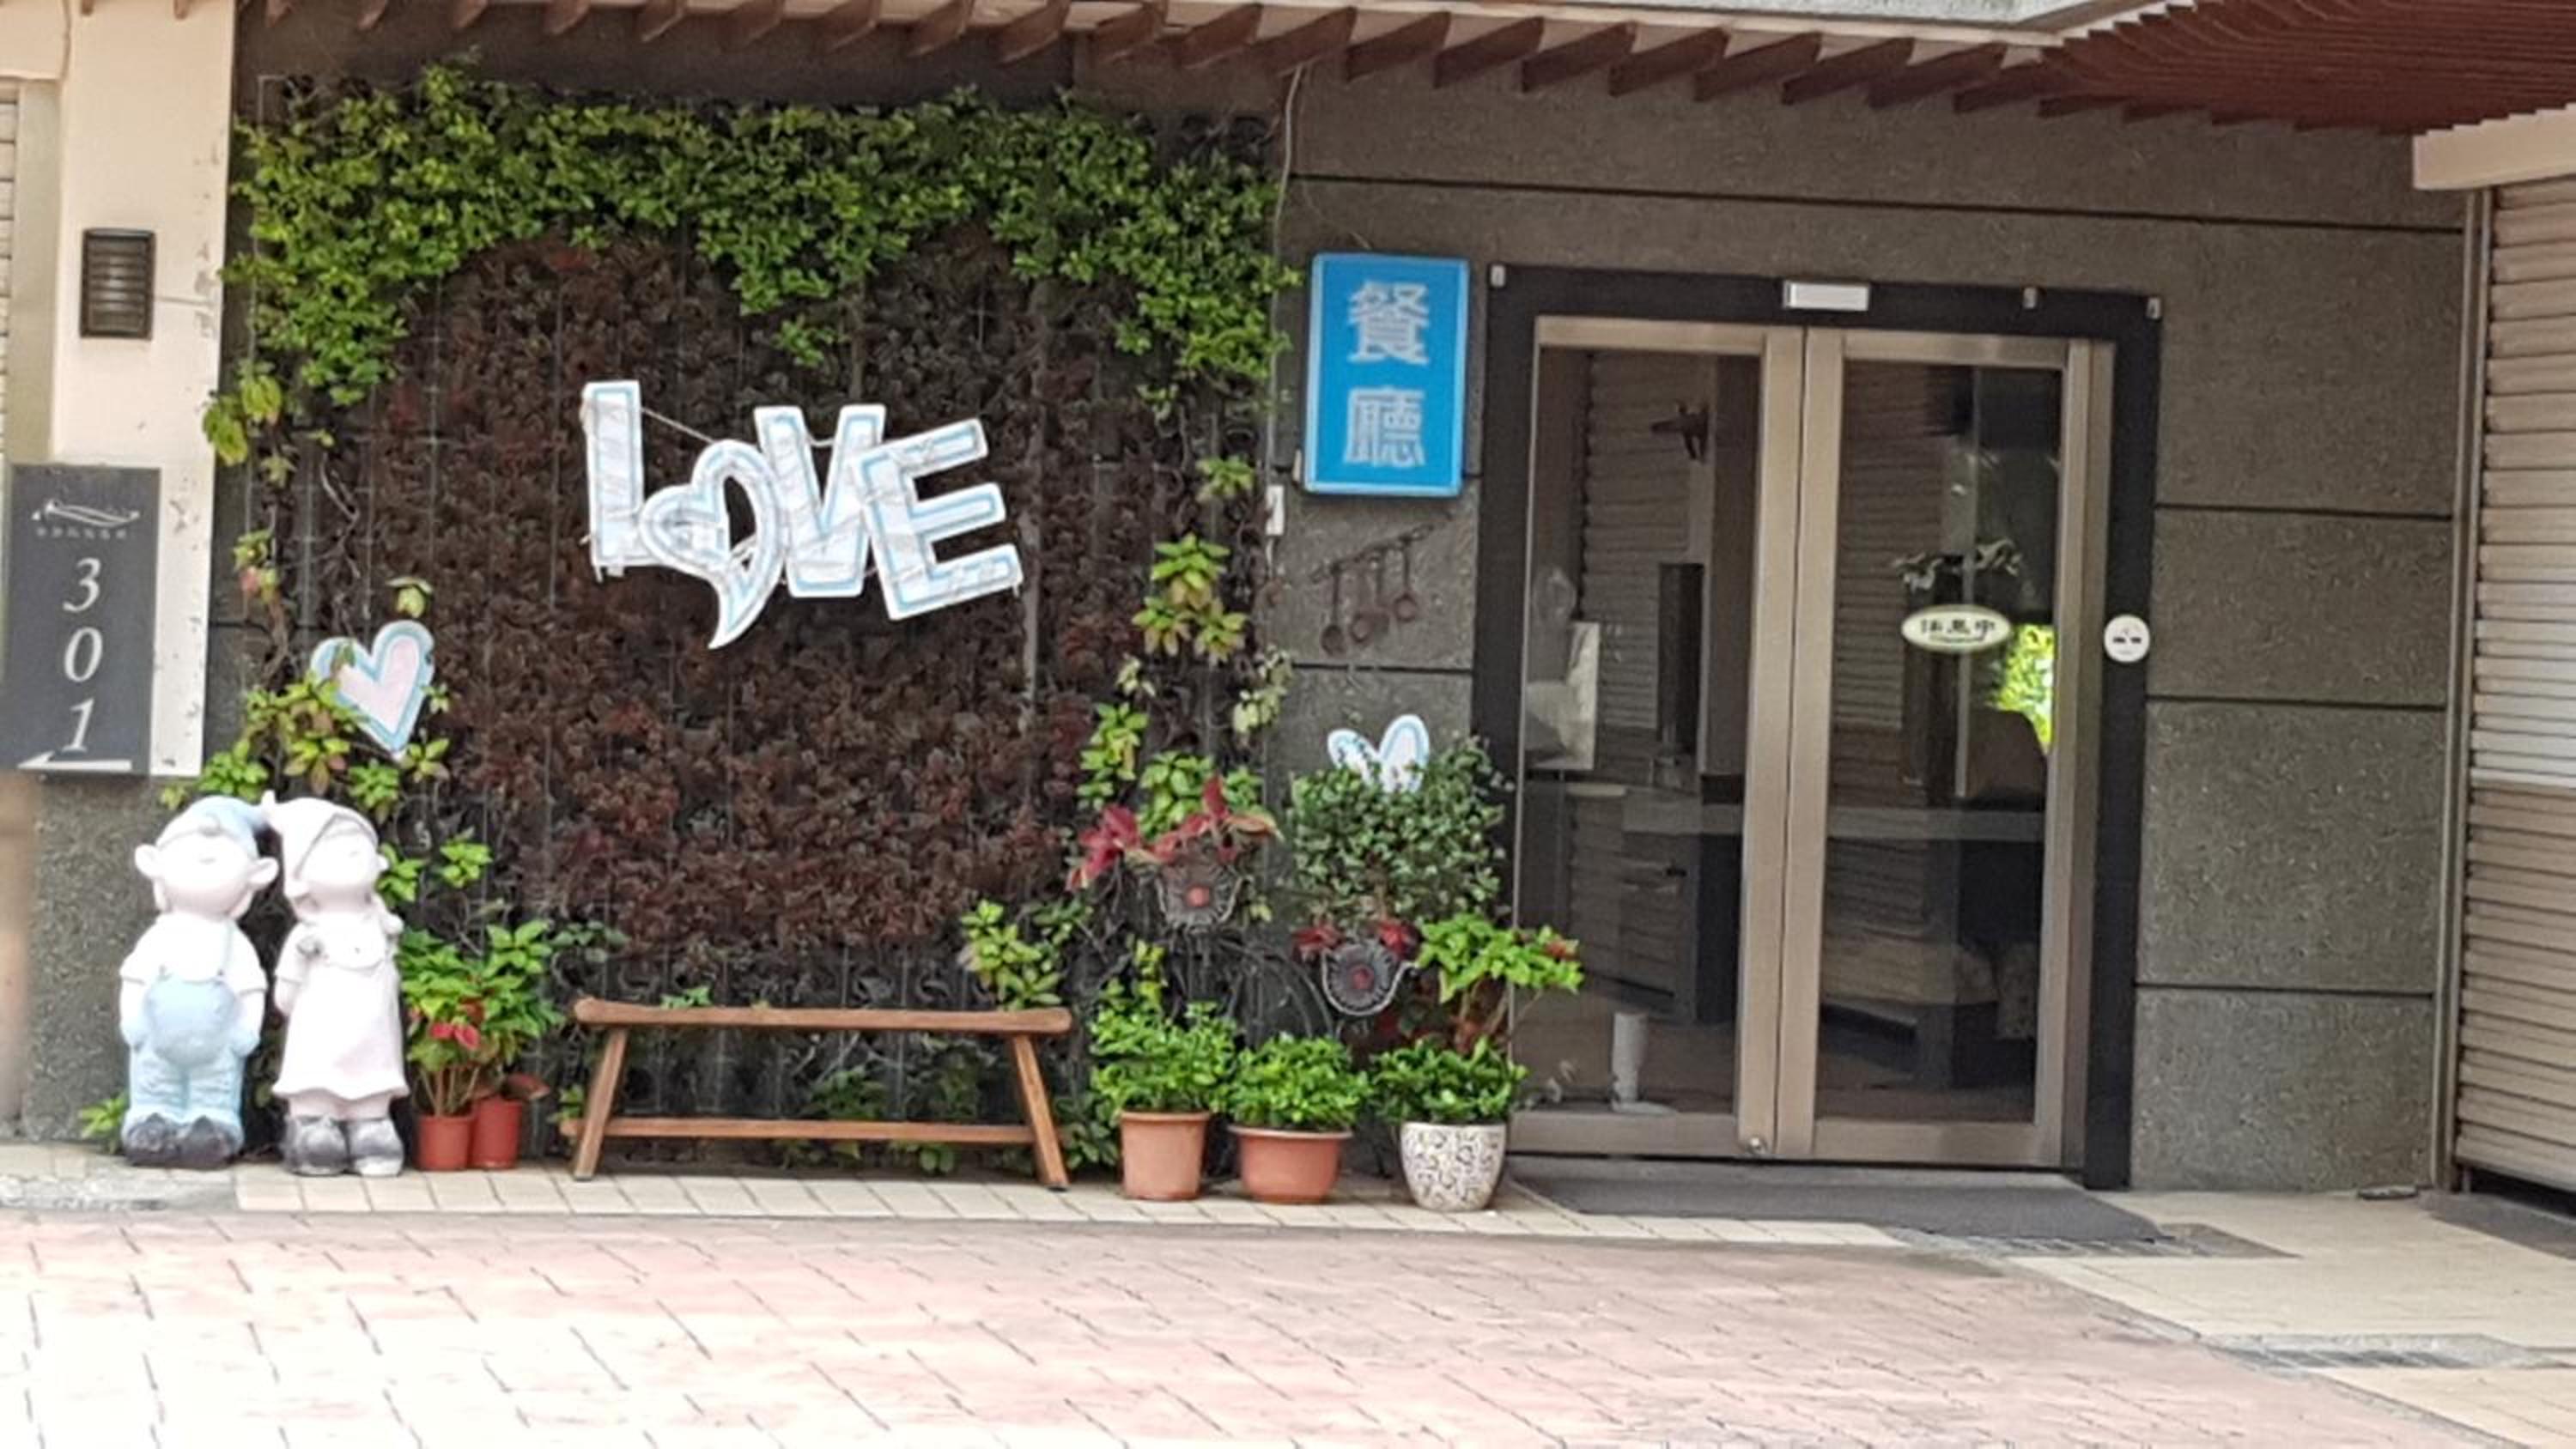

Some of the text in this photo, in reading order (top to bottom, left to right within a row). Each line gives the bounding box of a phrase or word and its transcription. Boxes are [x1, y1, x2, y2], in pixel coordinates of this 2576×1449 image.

[1345, 282, 1430, 468] 餐廳
[580, 379, 1024, 650] LOVE
[63, 557, 103, 752] 301
